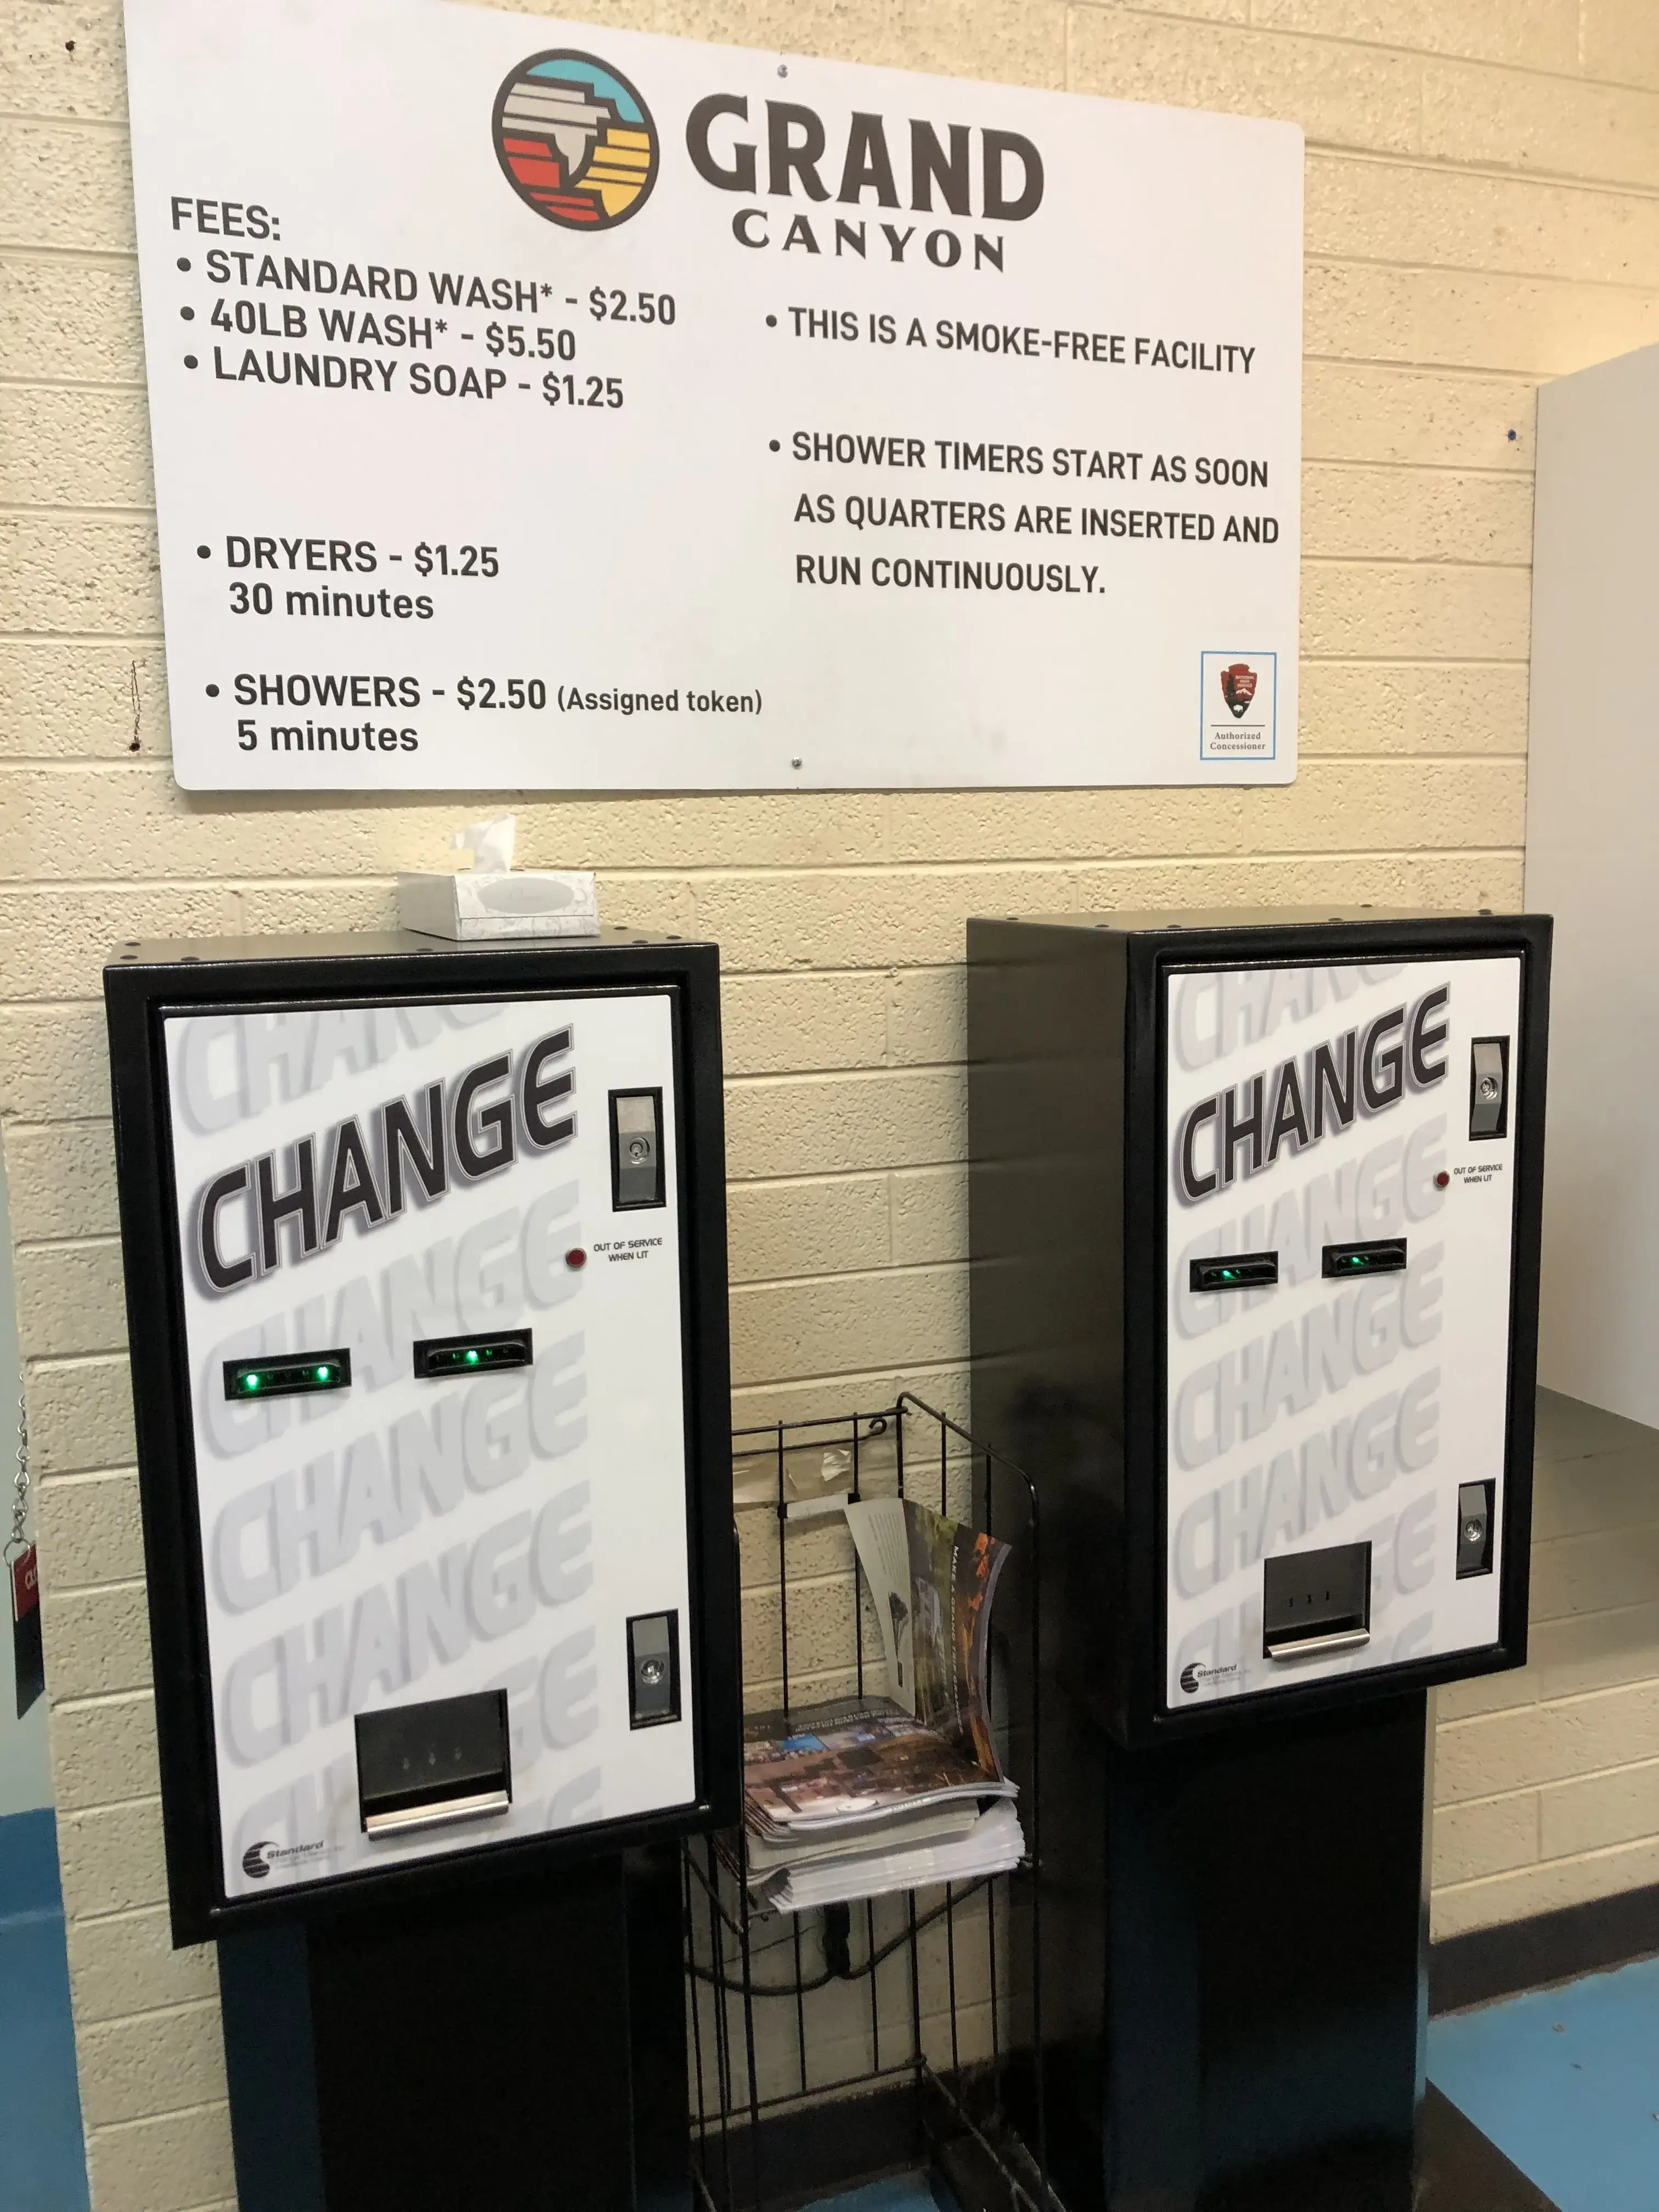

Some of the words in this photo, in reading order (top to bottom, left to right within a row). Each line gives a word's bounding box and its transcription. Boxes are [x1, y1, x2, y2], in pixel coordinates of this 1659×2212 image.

[686, 94, 1043, 221] GRAND
[171, 196, 280, 240] FEES:
[732, 210, 1003, 272] CANYON
[207, 250, 417, 301] STANDARD
[590, 286, 675, 325] $2.50
[211, 298, 307, 337] 40LB
[487, 322, 575, 360] $5.50
[788, 307, 858, 341] THIS
[870, 314, 896, 343] IS
[906, 318, 927, 347] A
[936, 320, 1125, 363] SMOKE-FREE
[1136, 338, 1255, 373] FACILITY
[215, 346, 397, 391] LAUNDRY
[410, 363, 506, 399] SOAP
[543, 371, 623, 408] $1.25
[793, 432, 926, 467] SHOWER
[935, 441, 1043, 474] TIMERS
[1053, 448, 1143, 479] START
[1151, 455, 1186, 482] AS
[1195, 458, 1267, 487] SOON
[794, 494, 834, 523] AS
[846, 496, 1005, 531] QUARTERS
[1014, 505, 1071, 534] ARE
[1082, 509, 1214, 540] INSERTED
[1223, 516, 1278, 543] AND
[227, 536, 377, 572] DRYERS
[415, 542, 498, 577] $1.25
[797, 555, 860, 585] RUN
[872, 558, 1104, 592] CONTINUOUSLY.
[230, 582, 272, 614] 30
[286, 585, 433, 619] minutes
[235, 674, 420, 707] SHOWERS
[458, 676, 545, 710] $2.50
[558, 686, 678, 715] (Assigned
[686, 690, 761, 714] token)
[238, 720, 257, 751] 5
[271, 720, 418, 751] minutes
[1210, 742, 1266, 750] Concessioner
[1214, 731, 1261, 740] Authorized
[1180, 981, 1451, 1201] CHANGE
[198, 1023, 578, 1293] CHANGE
[1464, 1175, 1482, 1183] WHEN
[1478, 1164, 1503, 1173] SERVICE
[594, 1243, 611, 1252] OUT
[613, 1242, 625, 1250] OF
[628, 1238, 663, 1249] SERVICE
[608, 1252, 634, 1262] WHEN
[636, 1250, 649, 1259] LIT
[1175, 1242, 1445, 1472] CHANGE
[211, 1331, 588, 1616] CHANGE
[1173, 1367, 1441, 1601] CHANGE
[951, 1545, 959, 1582] MAKE
[222, 1481, 595, 1769] CHANGE
